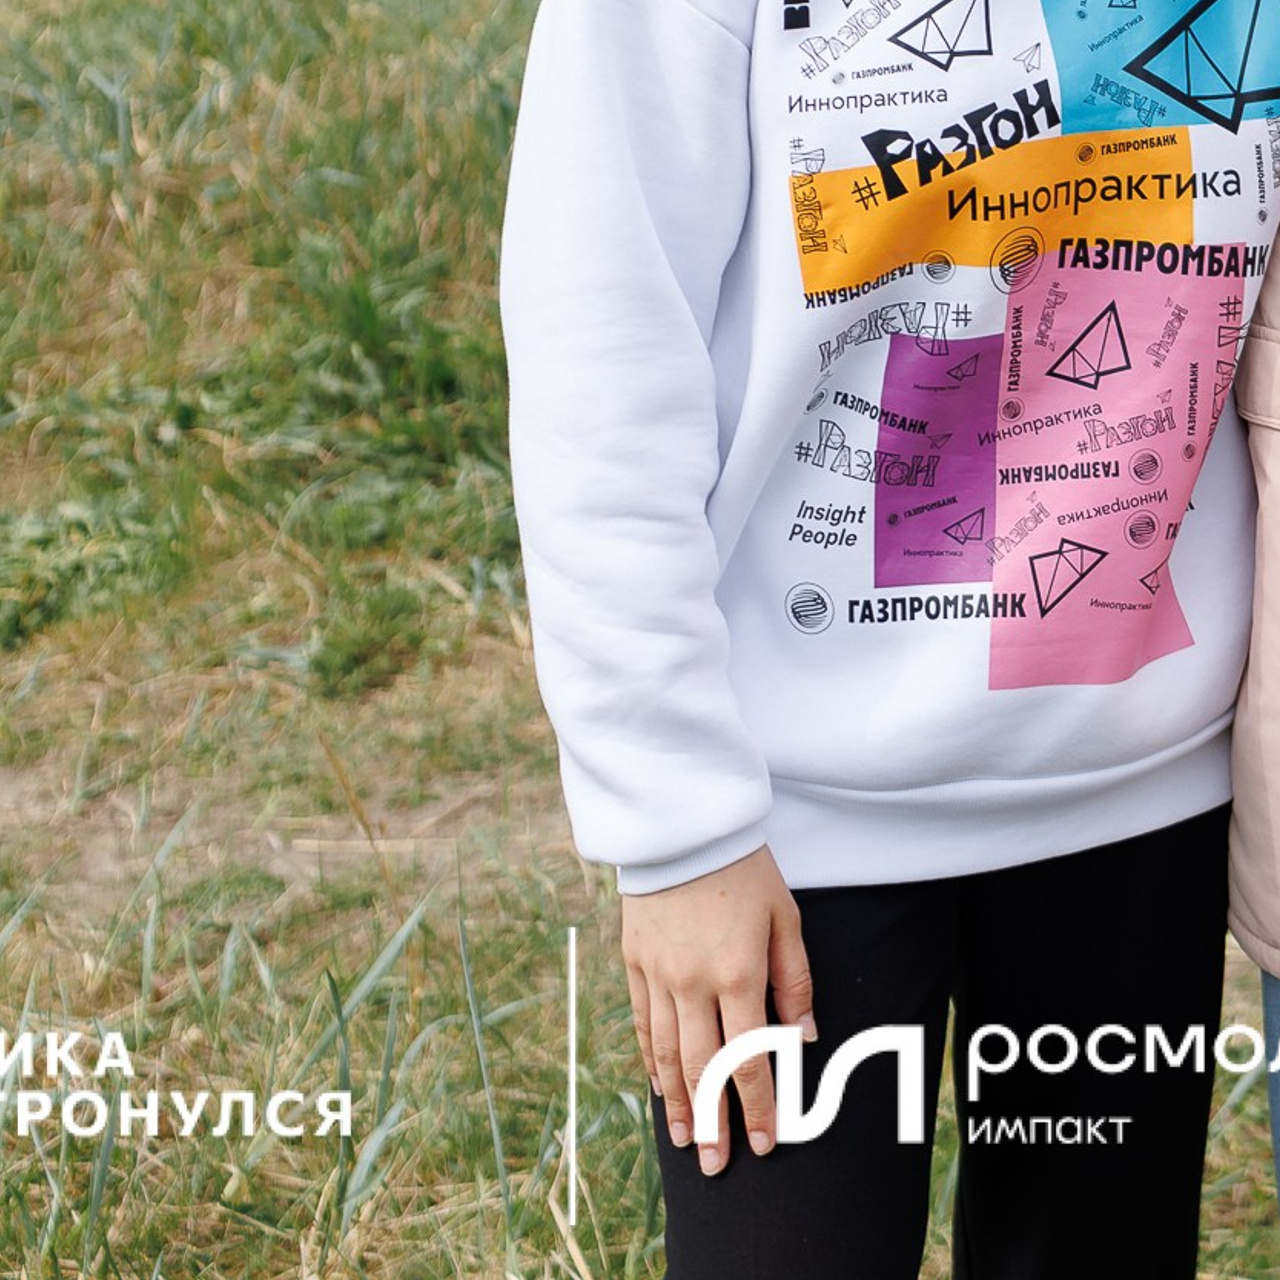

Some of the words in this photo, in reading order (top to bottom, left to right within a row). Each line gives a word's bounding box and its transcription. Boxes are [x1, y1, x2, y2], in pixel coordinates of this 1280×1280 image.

[1088, 14, 1144, 53] Иннопрактика
[851, 63, 914, 80] ГАЗПРОМБАНК
[788, 88, 948, 113] Иннопрактика
[1100, 133, 1178, 156] ГАЗПРОМБАНК
[948, 169, 1241, 221] Иннопрактика
[1057, 237, 1270, 279] ГАЗПРОМБАНК
[804, 261, 914, 309] ГАЗПРОМБАНК
[1007, 305, 1023, 392] ГАЗПРОМБАНК
[833, 390, 929, 435] ГАЗПРОМБАНК
[1187, 361, 1199, 437] ГАЗПРОМБАНК
[977, 402, 1103, 447] Иннопрактика
[998, 460, 1120, 486] ГАЗПРОМБАНК
[796, 500, 866, 524] Insight
[903, 496, 958, 519] ГАЗПРОМБАНК
[1056, 488, 1169, 526] Иннопрактика
[788, 524, 858, 549] People
[848, 593, 1027, 624] ГАЗПРОМБАНК
